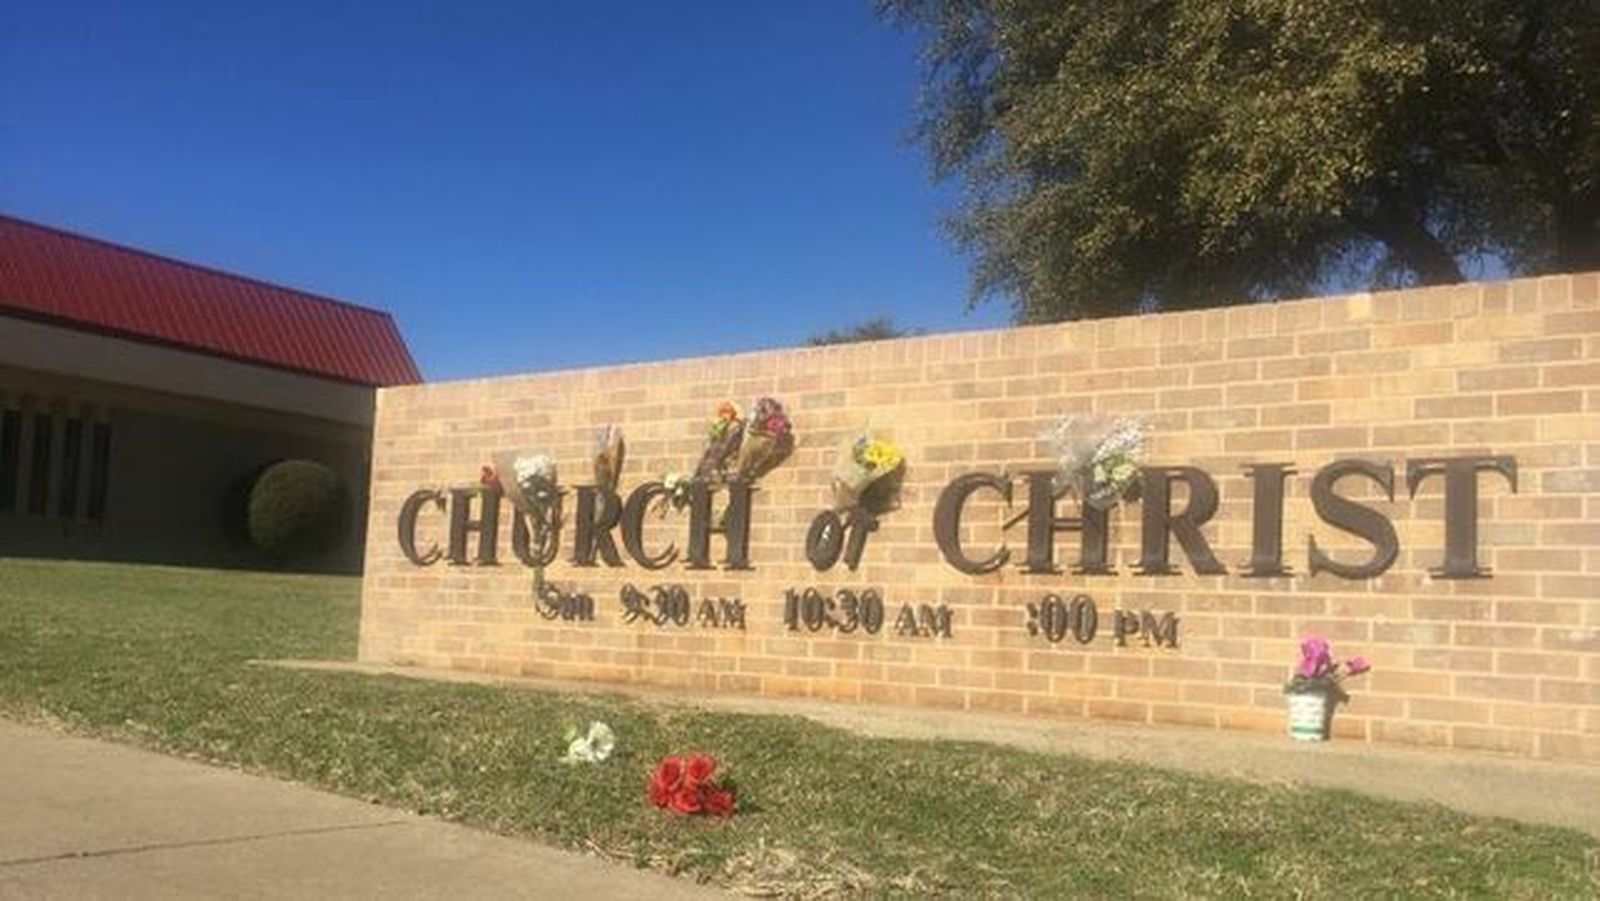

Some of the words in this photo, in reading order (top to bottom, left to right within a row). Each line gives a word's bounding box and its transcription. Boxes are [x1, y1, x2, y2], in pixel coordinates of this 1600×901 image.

[397, 484, 760, 571] CHURCH
[806, 500, 881, 572] of
[933, 455, 1518, 581] CHRIST
[535, 580, 595, 621] Sun
[620, 582, 691, 627] 9:30
[697, 598, 747, 631] AM
[783, 586, 884, 635] 10:30
[895, 602, 954, 638] AM
[1026, 593, 1098, 645] :00
[1114, 609, 1180, 648] PM
